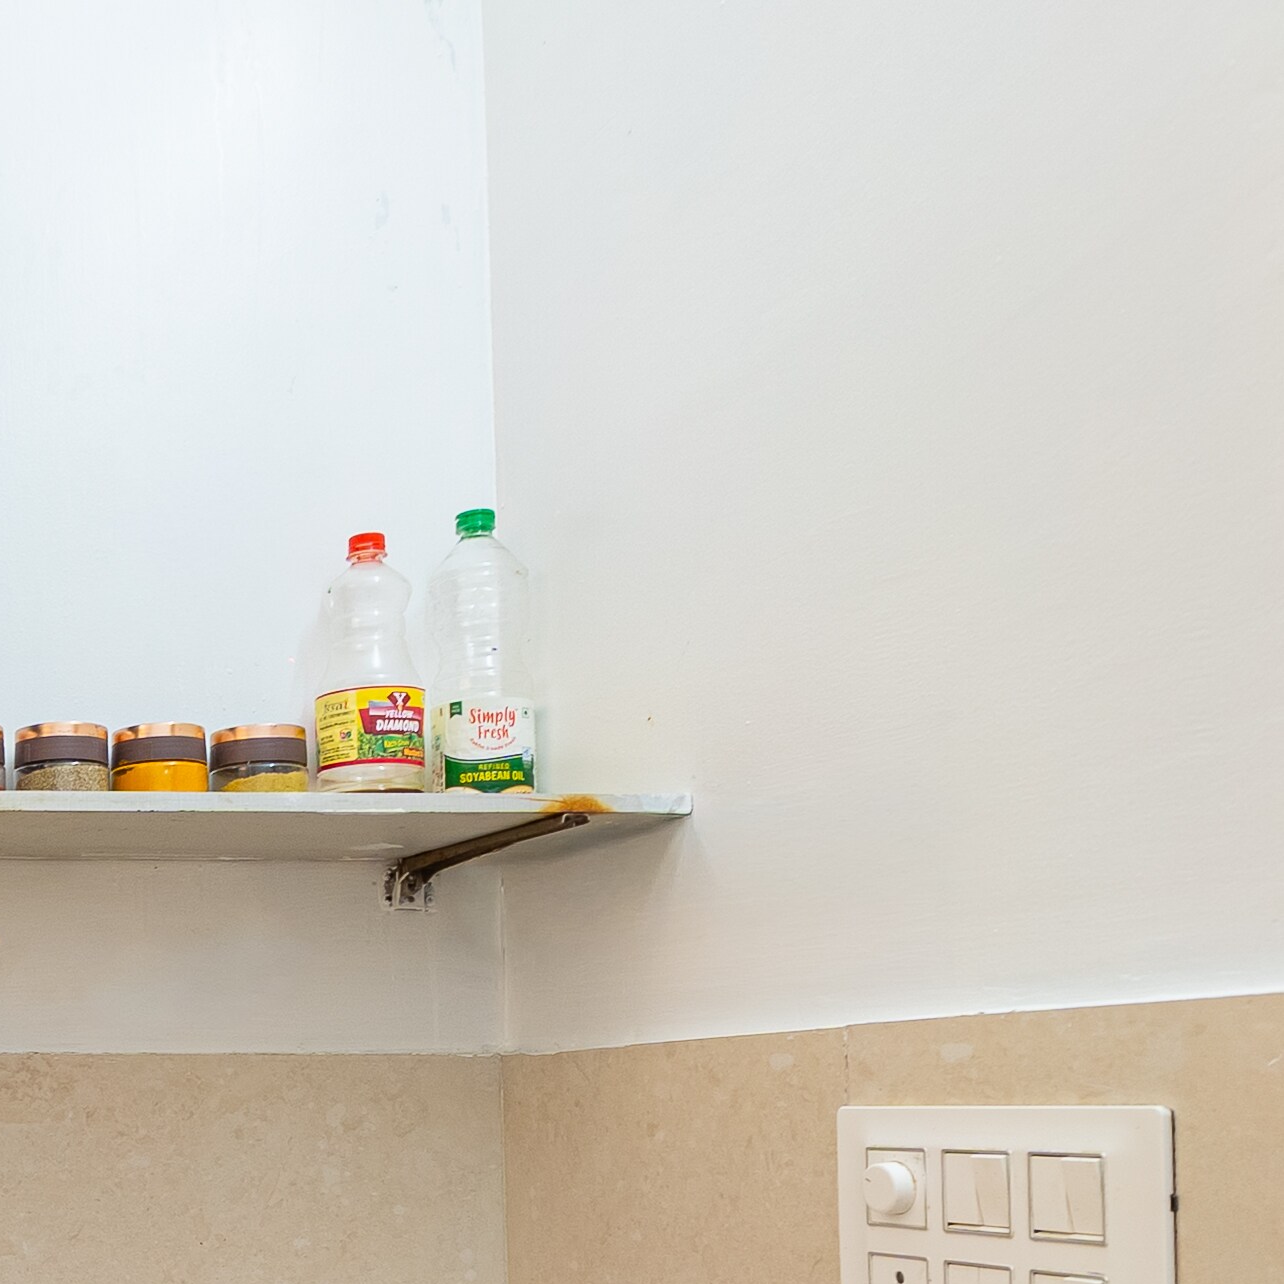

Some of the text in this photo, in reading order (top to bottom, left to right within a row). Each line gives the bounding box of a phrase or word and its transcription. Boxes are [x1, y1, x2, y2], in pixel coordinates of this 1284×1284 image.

[384, 710, 414, 719] YELLOW
[469, 706, 516, 728] Simply
[375, 719, 420, 733] DIAMOND
[477, 724, 509, 740] Fresh
[459, 770, 525, 784] SOYABEAN OIL
